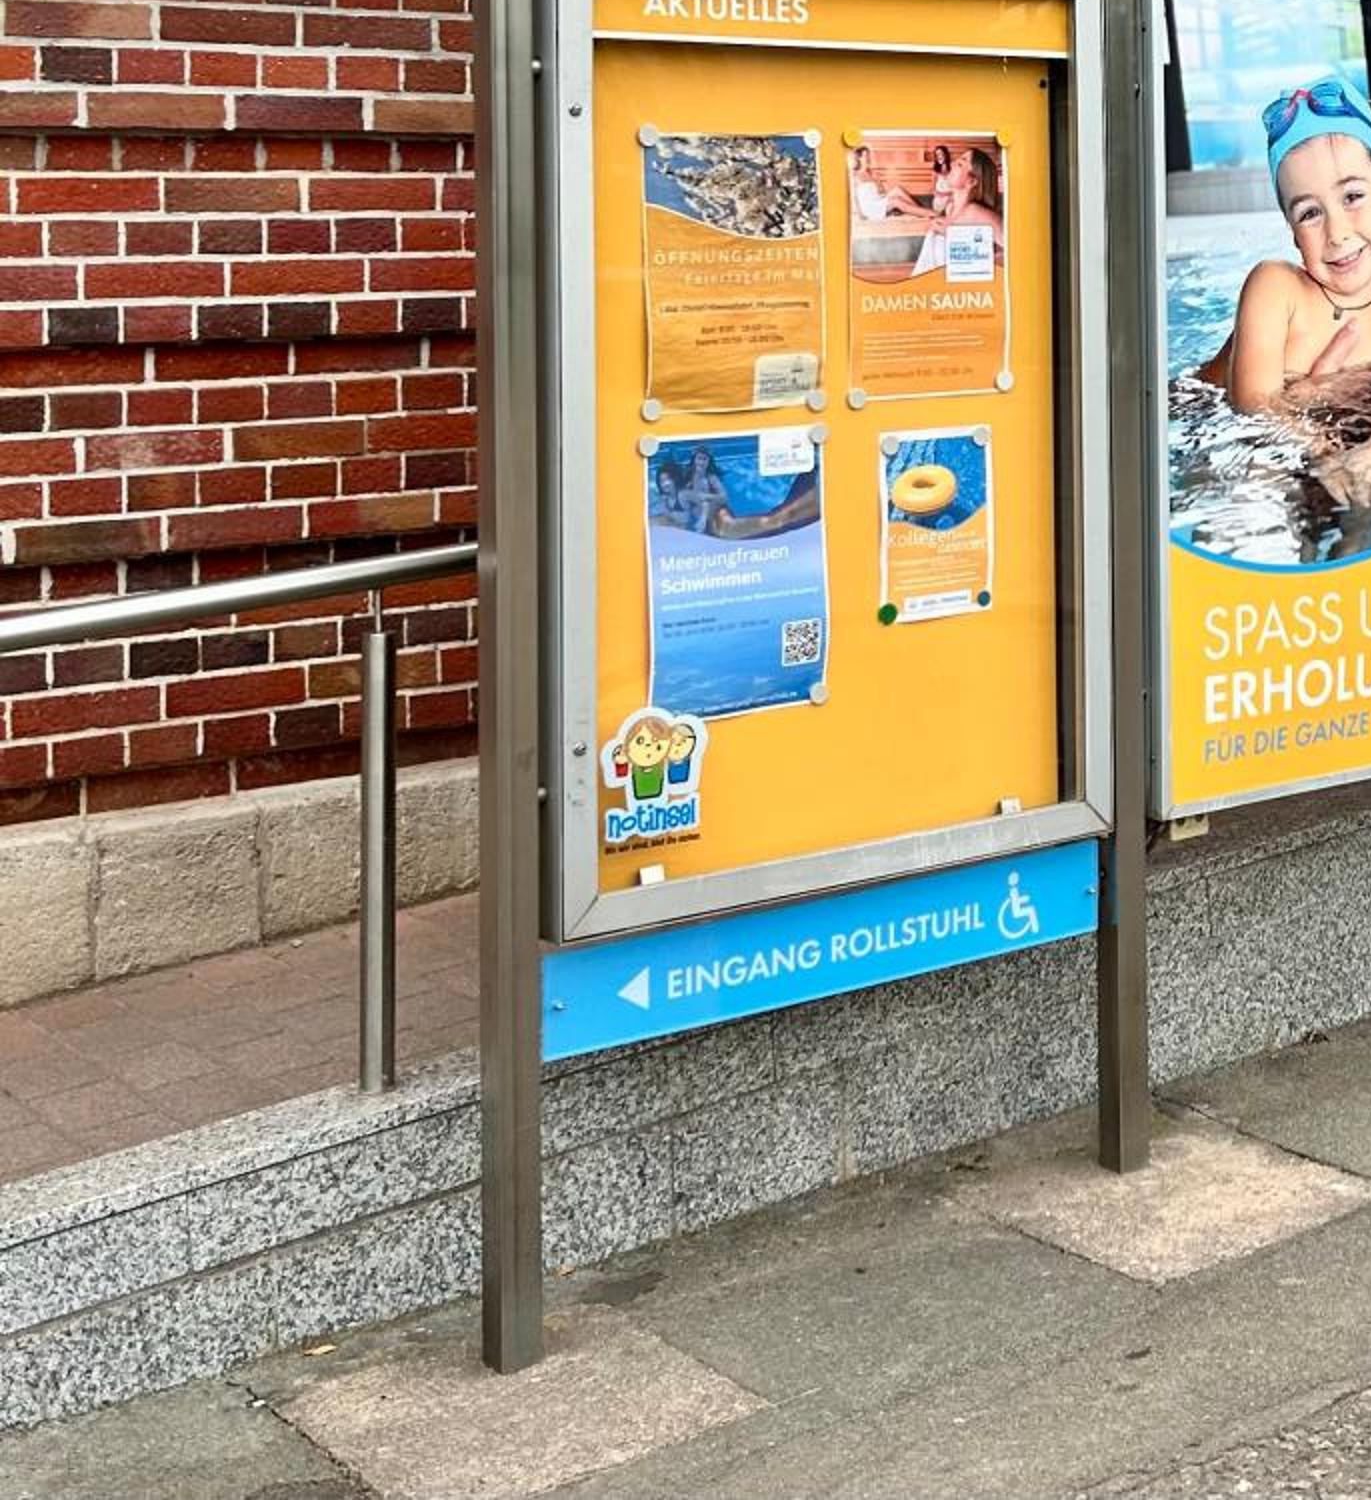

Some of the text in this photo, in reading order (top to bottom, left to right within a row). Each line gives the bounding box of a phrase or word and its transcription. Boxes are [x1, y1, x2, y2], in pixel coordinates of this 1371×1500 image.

[654, 246, 818, 266] ÖFFNUNGSZEITEN
[862, 291, 994, 314] DAMEN SAUNA
[659, 542, 790, 574] Meerjungfrauen
[660, 569, 763, 596] Schwimmen
[1203, 591, 1344, 661] SPASS
[1204, 730, 1248, 765] FÜR
[1254, 726, 1288, 756] DIE
[1295, 711, 1370, 748] GANZE
[607, 797, 697, 838] notinsel
[666, 901, 985, 1000] EINGANG ROLLSTUHL
